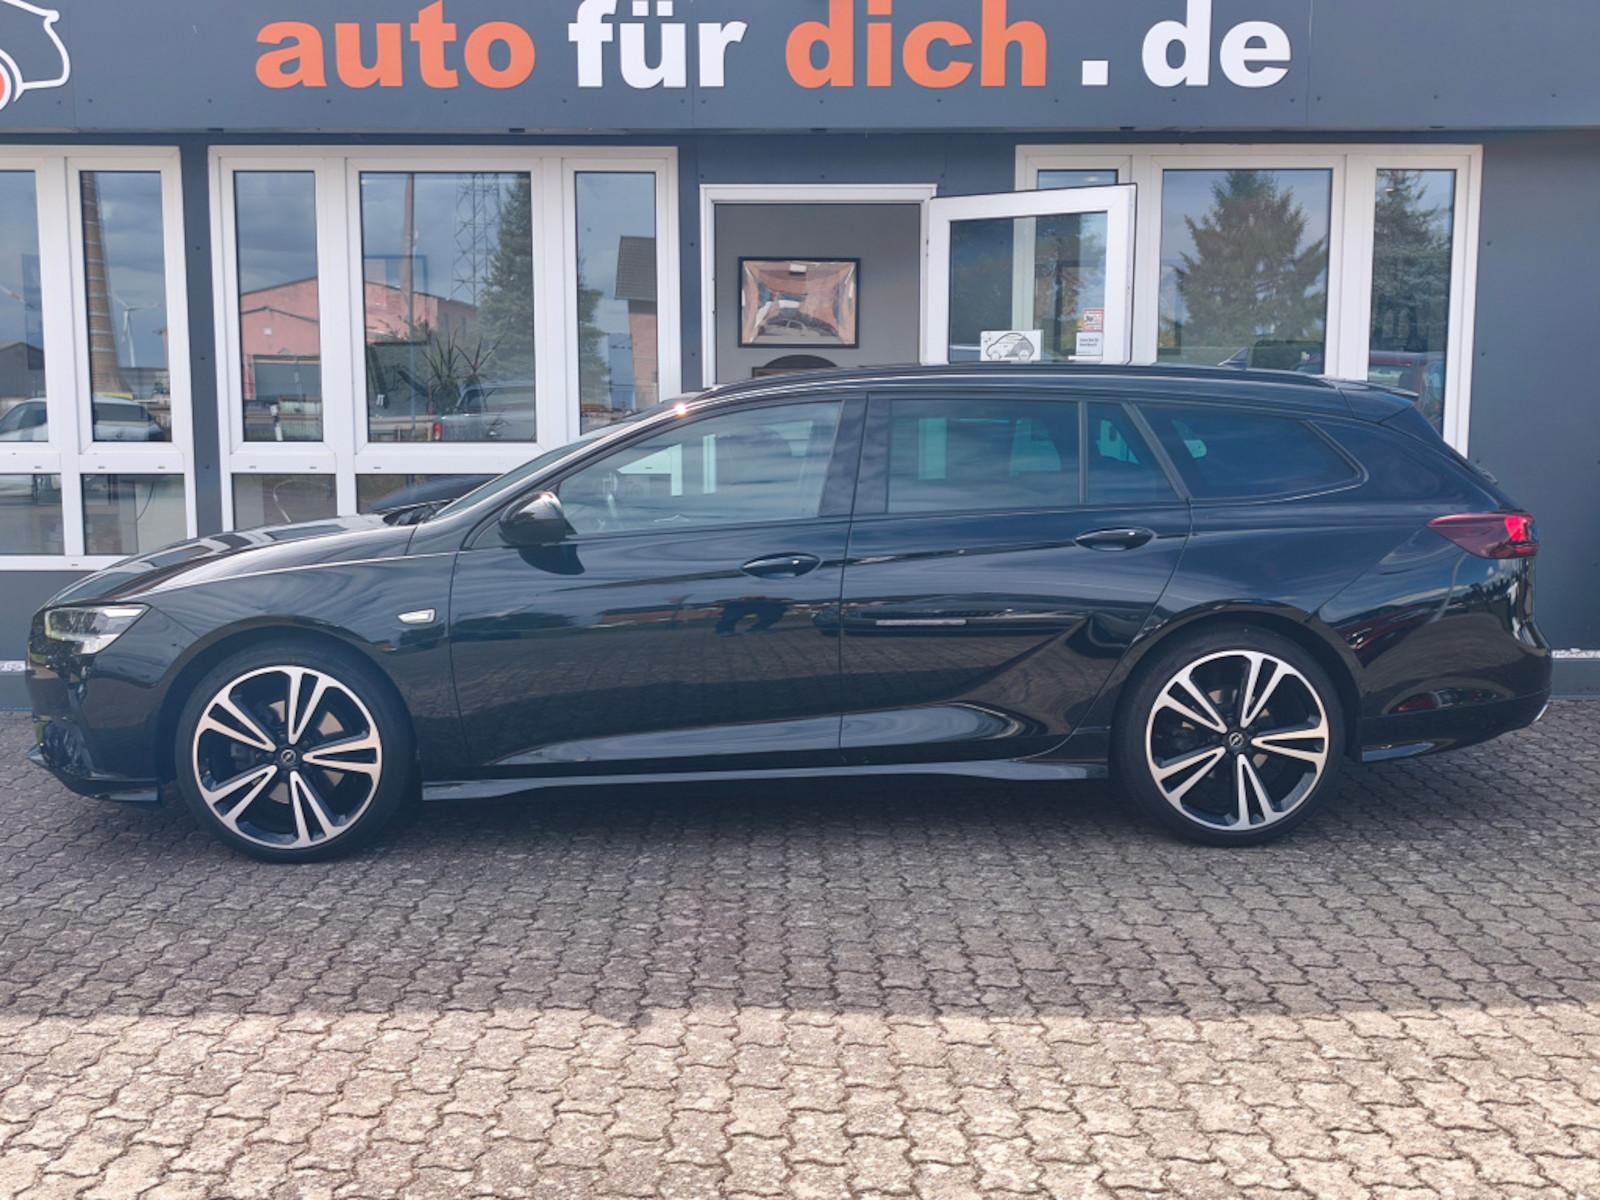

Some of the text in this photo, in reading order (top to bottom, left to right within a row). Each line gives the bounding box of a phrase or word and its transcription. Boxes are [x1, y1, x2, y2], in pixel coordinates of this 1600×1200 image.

[255, 0, 535, 89] auto
[568, 0, 748, 89] für
[785, 0, 1048, 89] dich
